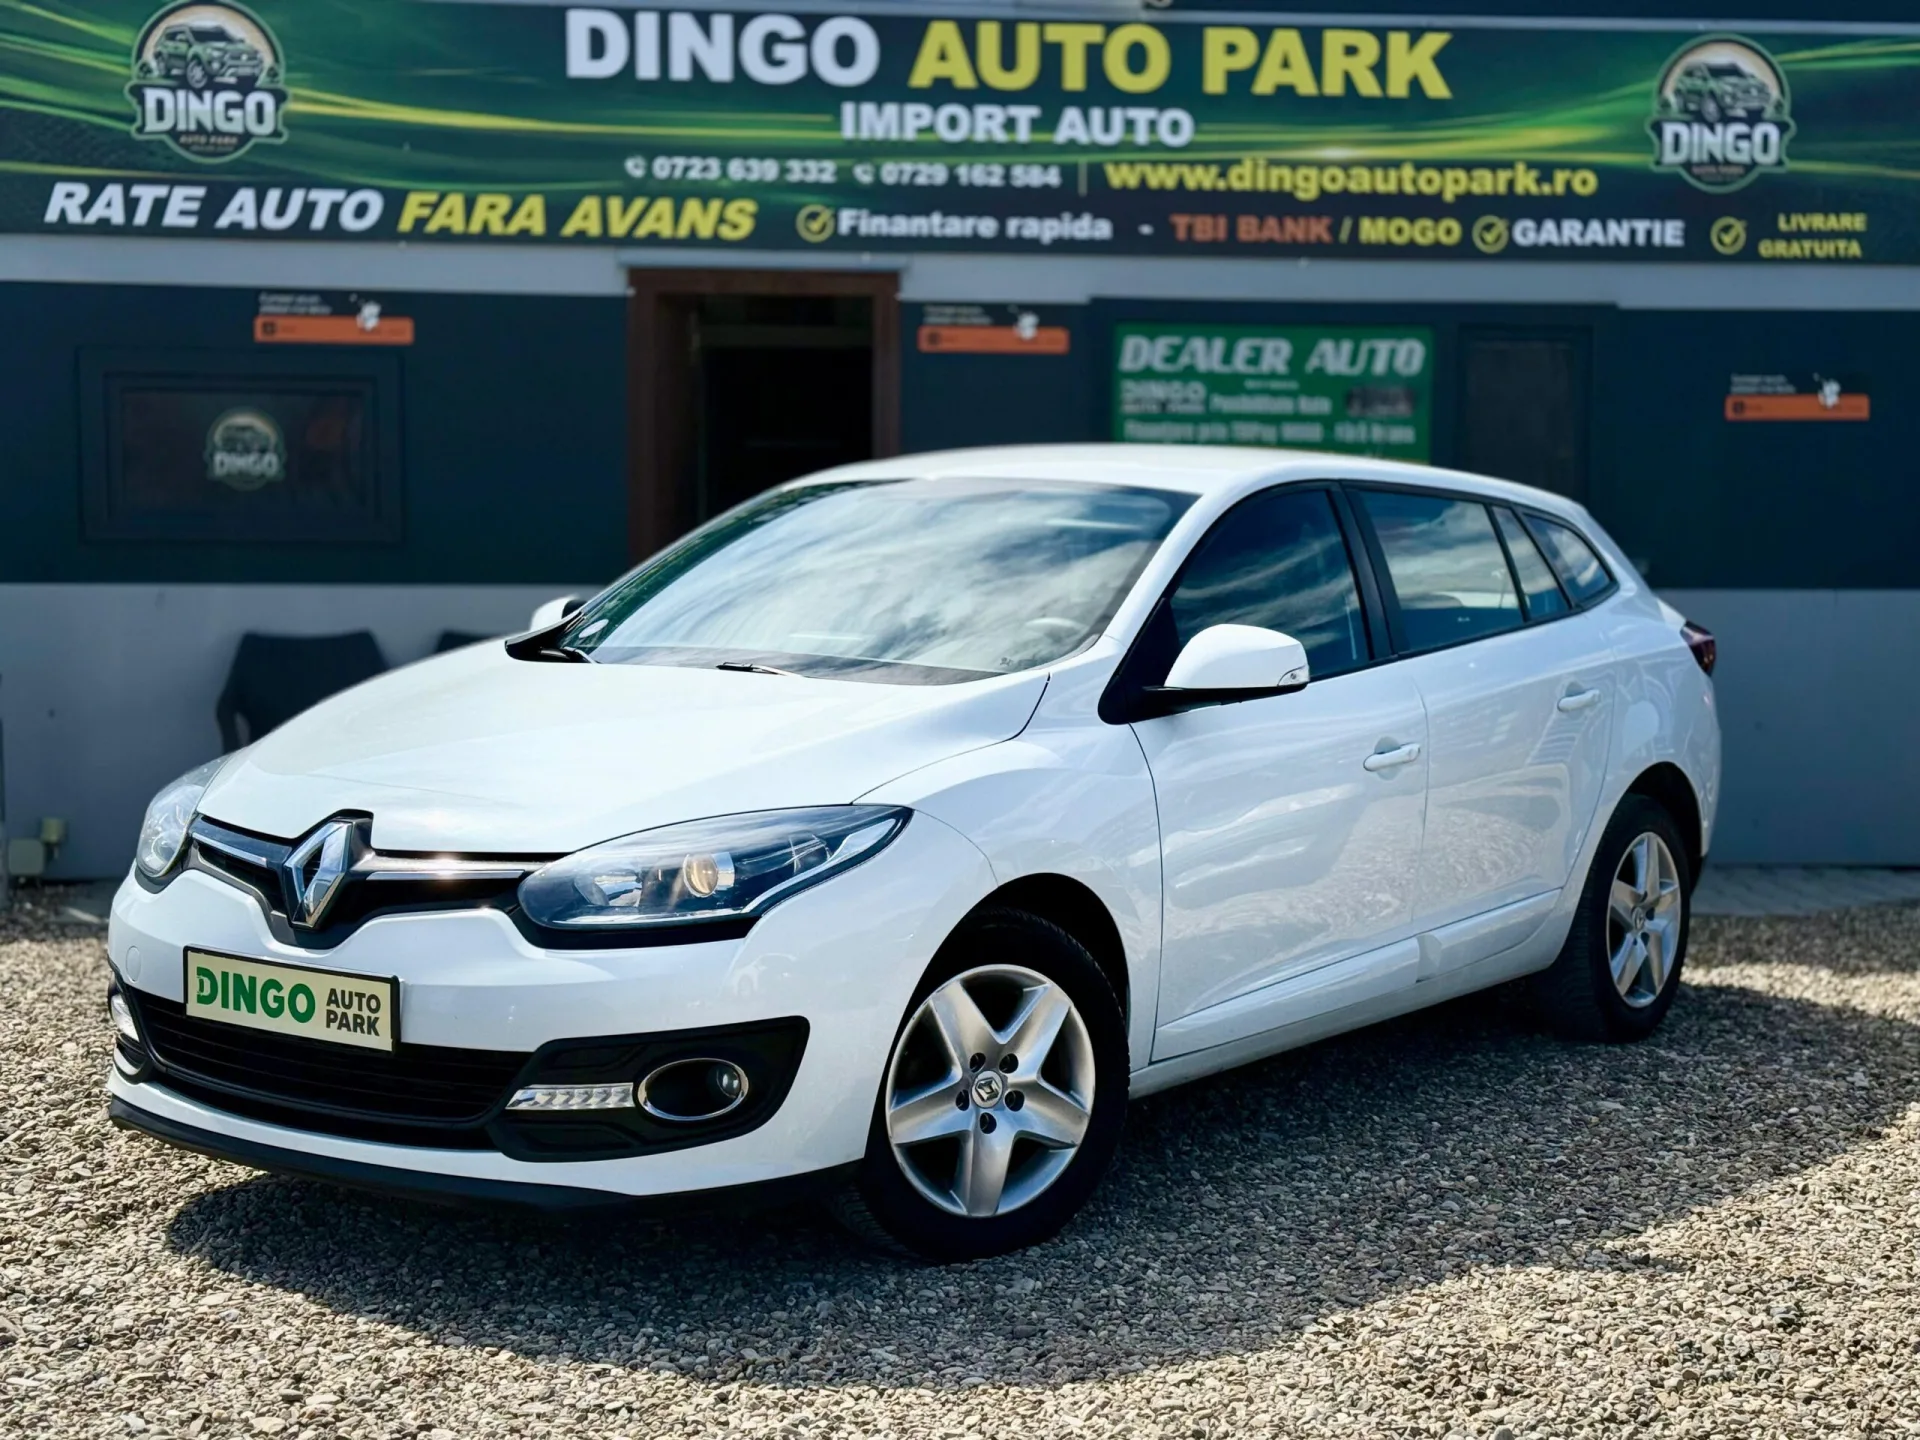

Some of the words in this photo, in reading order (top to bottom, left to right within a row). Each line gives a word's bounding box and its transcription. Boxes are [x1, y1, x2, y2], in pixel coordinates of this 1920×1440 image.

[566, 8, 880, 87] DINGO
[908, 20, 1171, 94] AUTO
[1203, 27, 1453, 100] PARK
[142, 87, 277, 136] DINGO
[840, 102, 1041, 141] IMPORT
[1054, 107, 1195, 147] AUTO
[1661, 121, 1781, 166] DINGO
[652, 156, 721, 180] 0723
[727, 158, 780, 182] 639
[785, 159, 838, 183] 332
[880, 162, 949, 186] 0729
[1105, 159, 1599, 201] www.dingoautopark.ro
[44, 182, 205, 228] RATE
[215, 188, 384, 231] AUTO
[397, 191, 546, 236] FARA
[560, 197, 758, 240] AVANS
[837, 208, 1000, 239] Finantare
[1005, 212, 1113, 245] rapida
[1170, 214, 1228, 242] TBI
[1236, 216, 1332, 243] BANK
[1358, 217, 1462, 246] MOGO
[1777, 213, 1868, 232] LIVRARE
[1511, 218, 1686, 247] GARANTIE
[1757, 239, 1863, 258] GRATUITA
[1119, 334, 1293, 375] DEALER
[1304, 338, 1427, 376] AUTO
[196, 966, 316, 1023] DINGO
[326, 988, 381, 1014] AUTO
[326, 1009, 380, 1037] PARK
